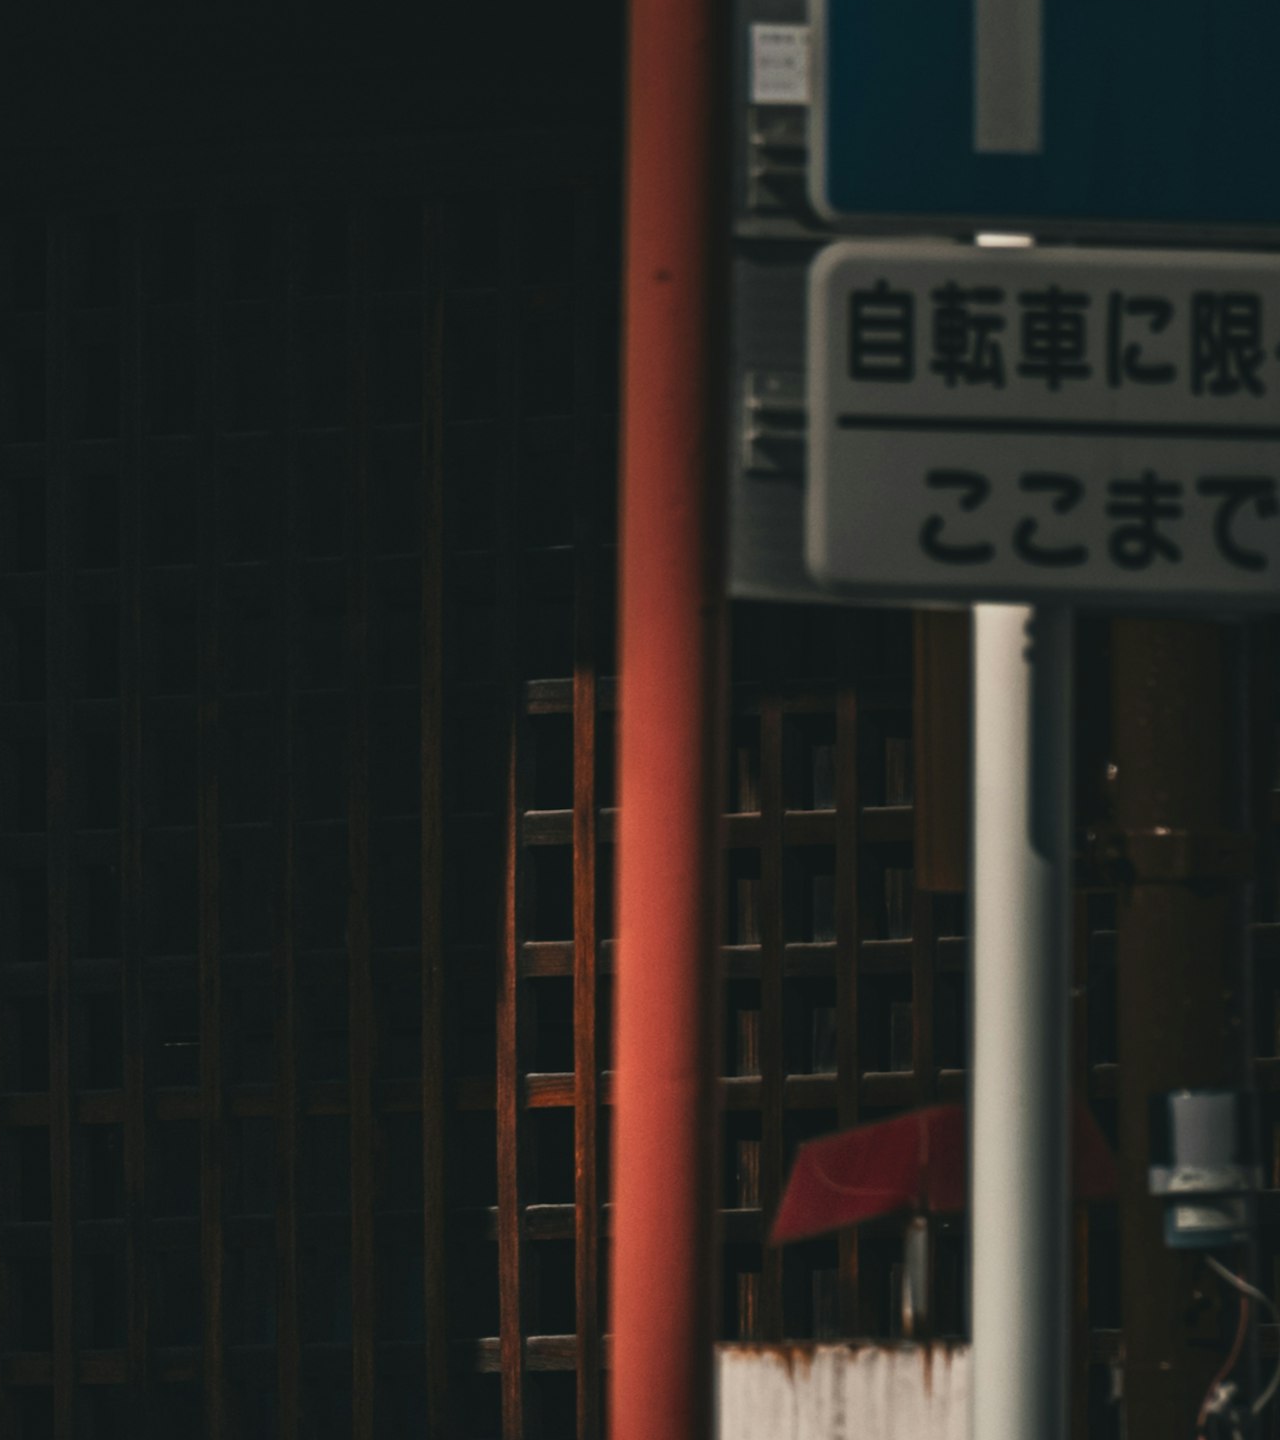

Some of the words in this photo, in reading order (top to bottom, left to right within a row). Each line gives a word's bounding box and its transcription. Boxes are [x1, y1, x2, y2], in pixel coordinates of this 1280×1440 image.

[849, 278, 1280, 397] 自転車に限
[919, 469, 1280, 572] ここまで
